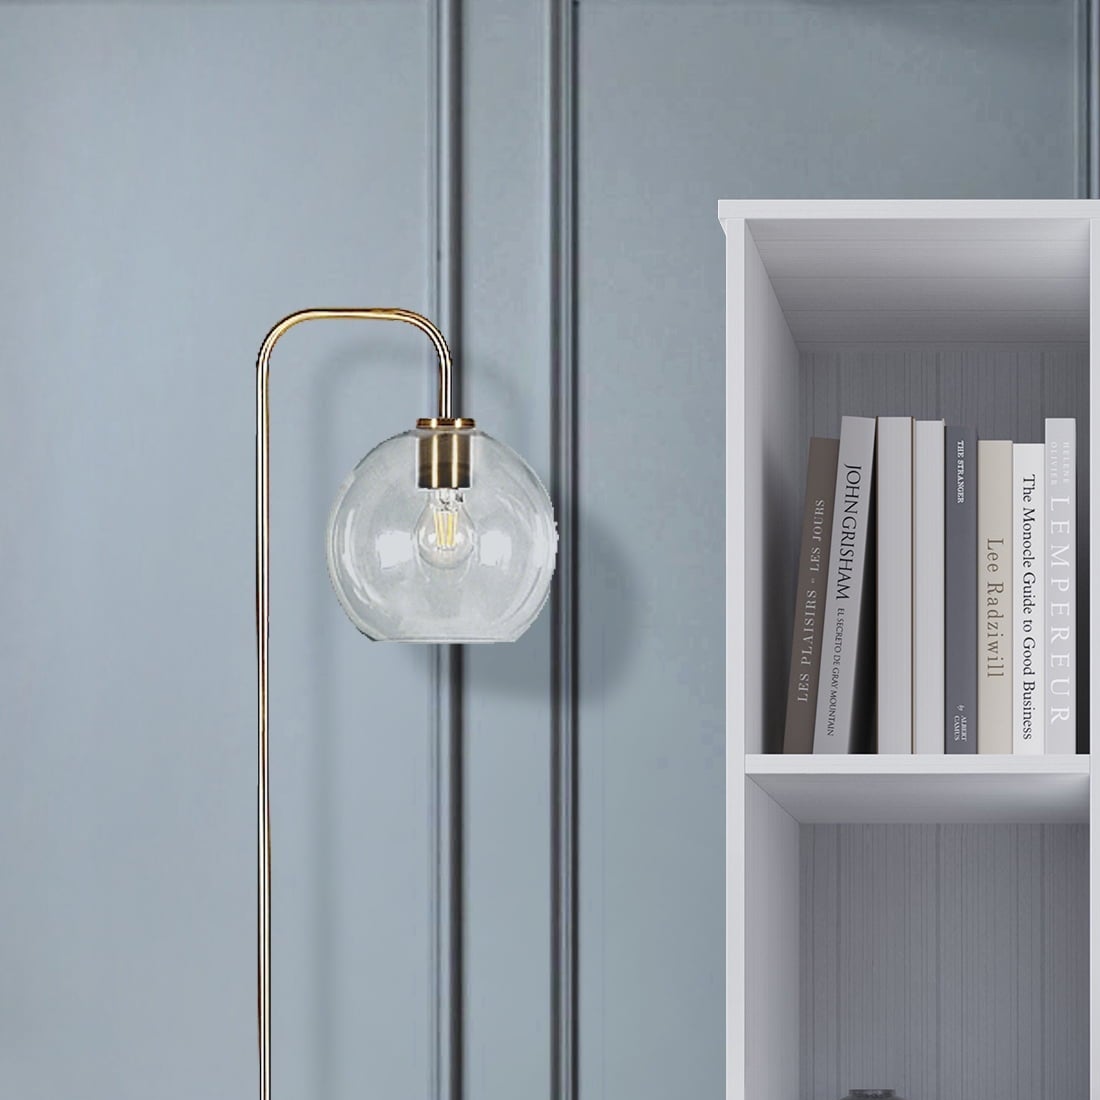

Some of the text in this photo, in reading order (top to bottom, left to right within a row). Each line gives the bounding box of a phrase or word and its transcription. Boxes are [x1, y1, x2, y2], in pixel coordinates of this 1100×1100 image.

[957, 440, 965, 504] THE STRANGER
[809, 499, 825, 572] LES JOURS
[797, 589, 817, 703] LES PLAISIRS
[987, 538, 1004, 678] Lee Radziwill
[1022, 473, 1036, 740] The Monocle Guide to Good Business
[826, 607, 845, 737] EL SECRETO DE GRAY MOUNTAIN
